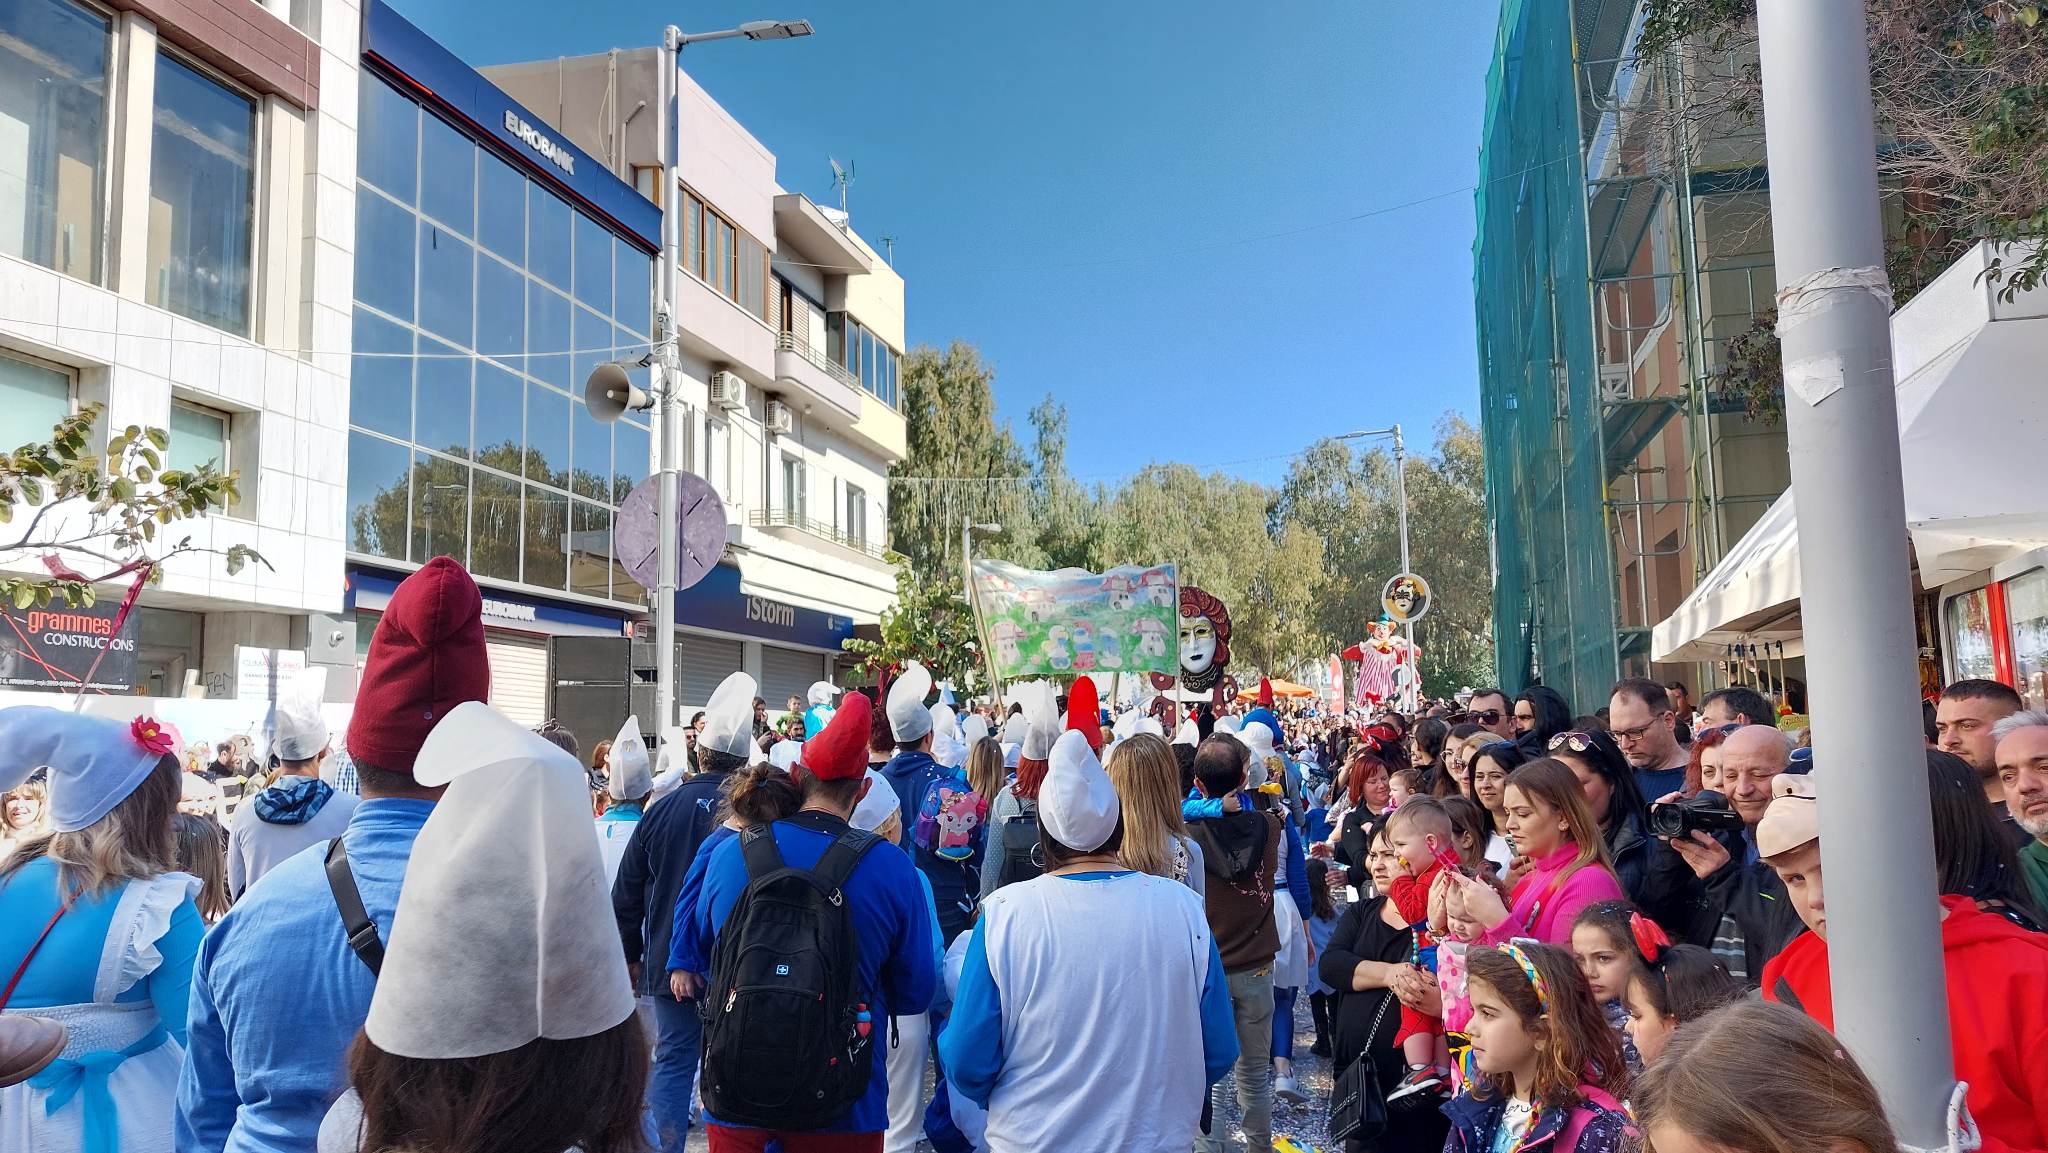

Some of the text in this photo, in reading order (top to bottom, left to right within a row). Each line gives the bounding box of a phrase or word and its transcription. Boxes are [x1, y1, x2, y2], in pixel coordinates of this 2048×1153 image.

[505, 109, 575, 176] EUROBANK
[28, 611, 111, 634] grammes
[746, 597, 795, 628] iStorm
